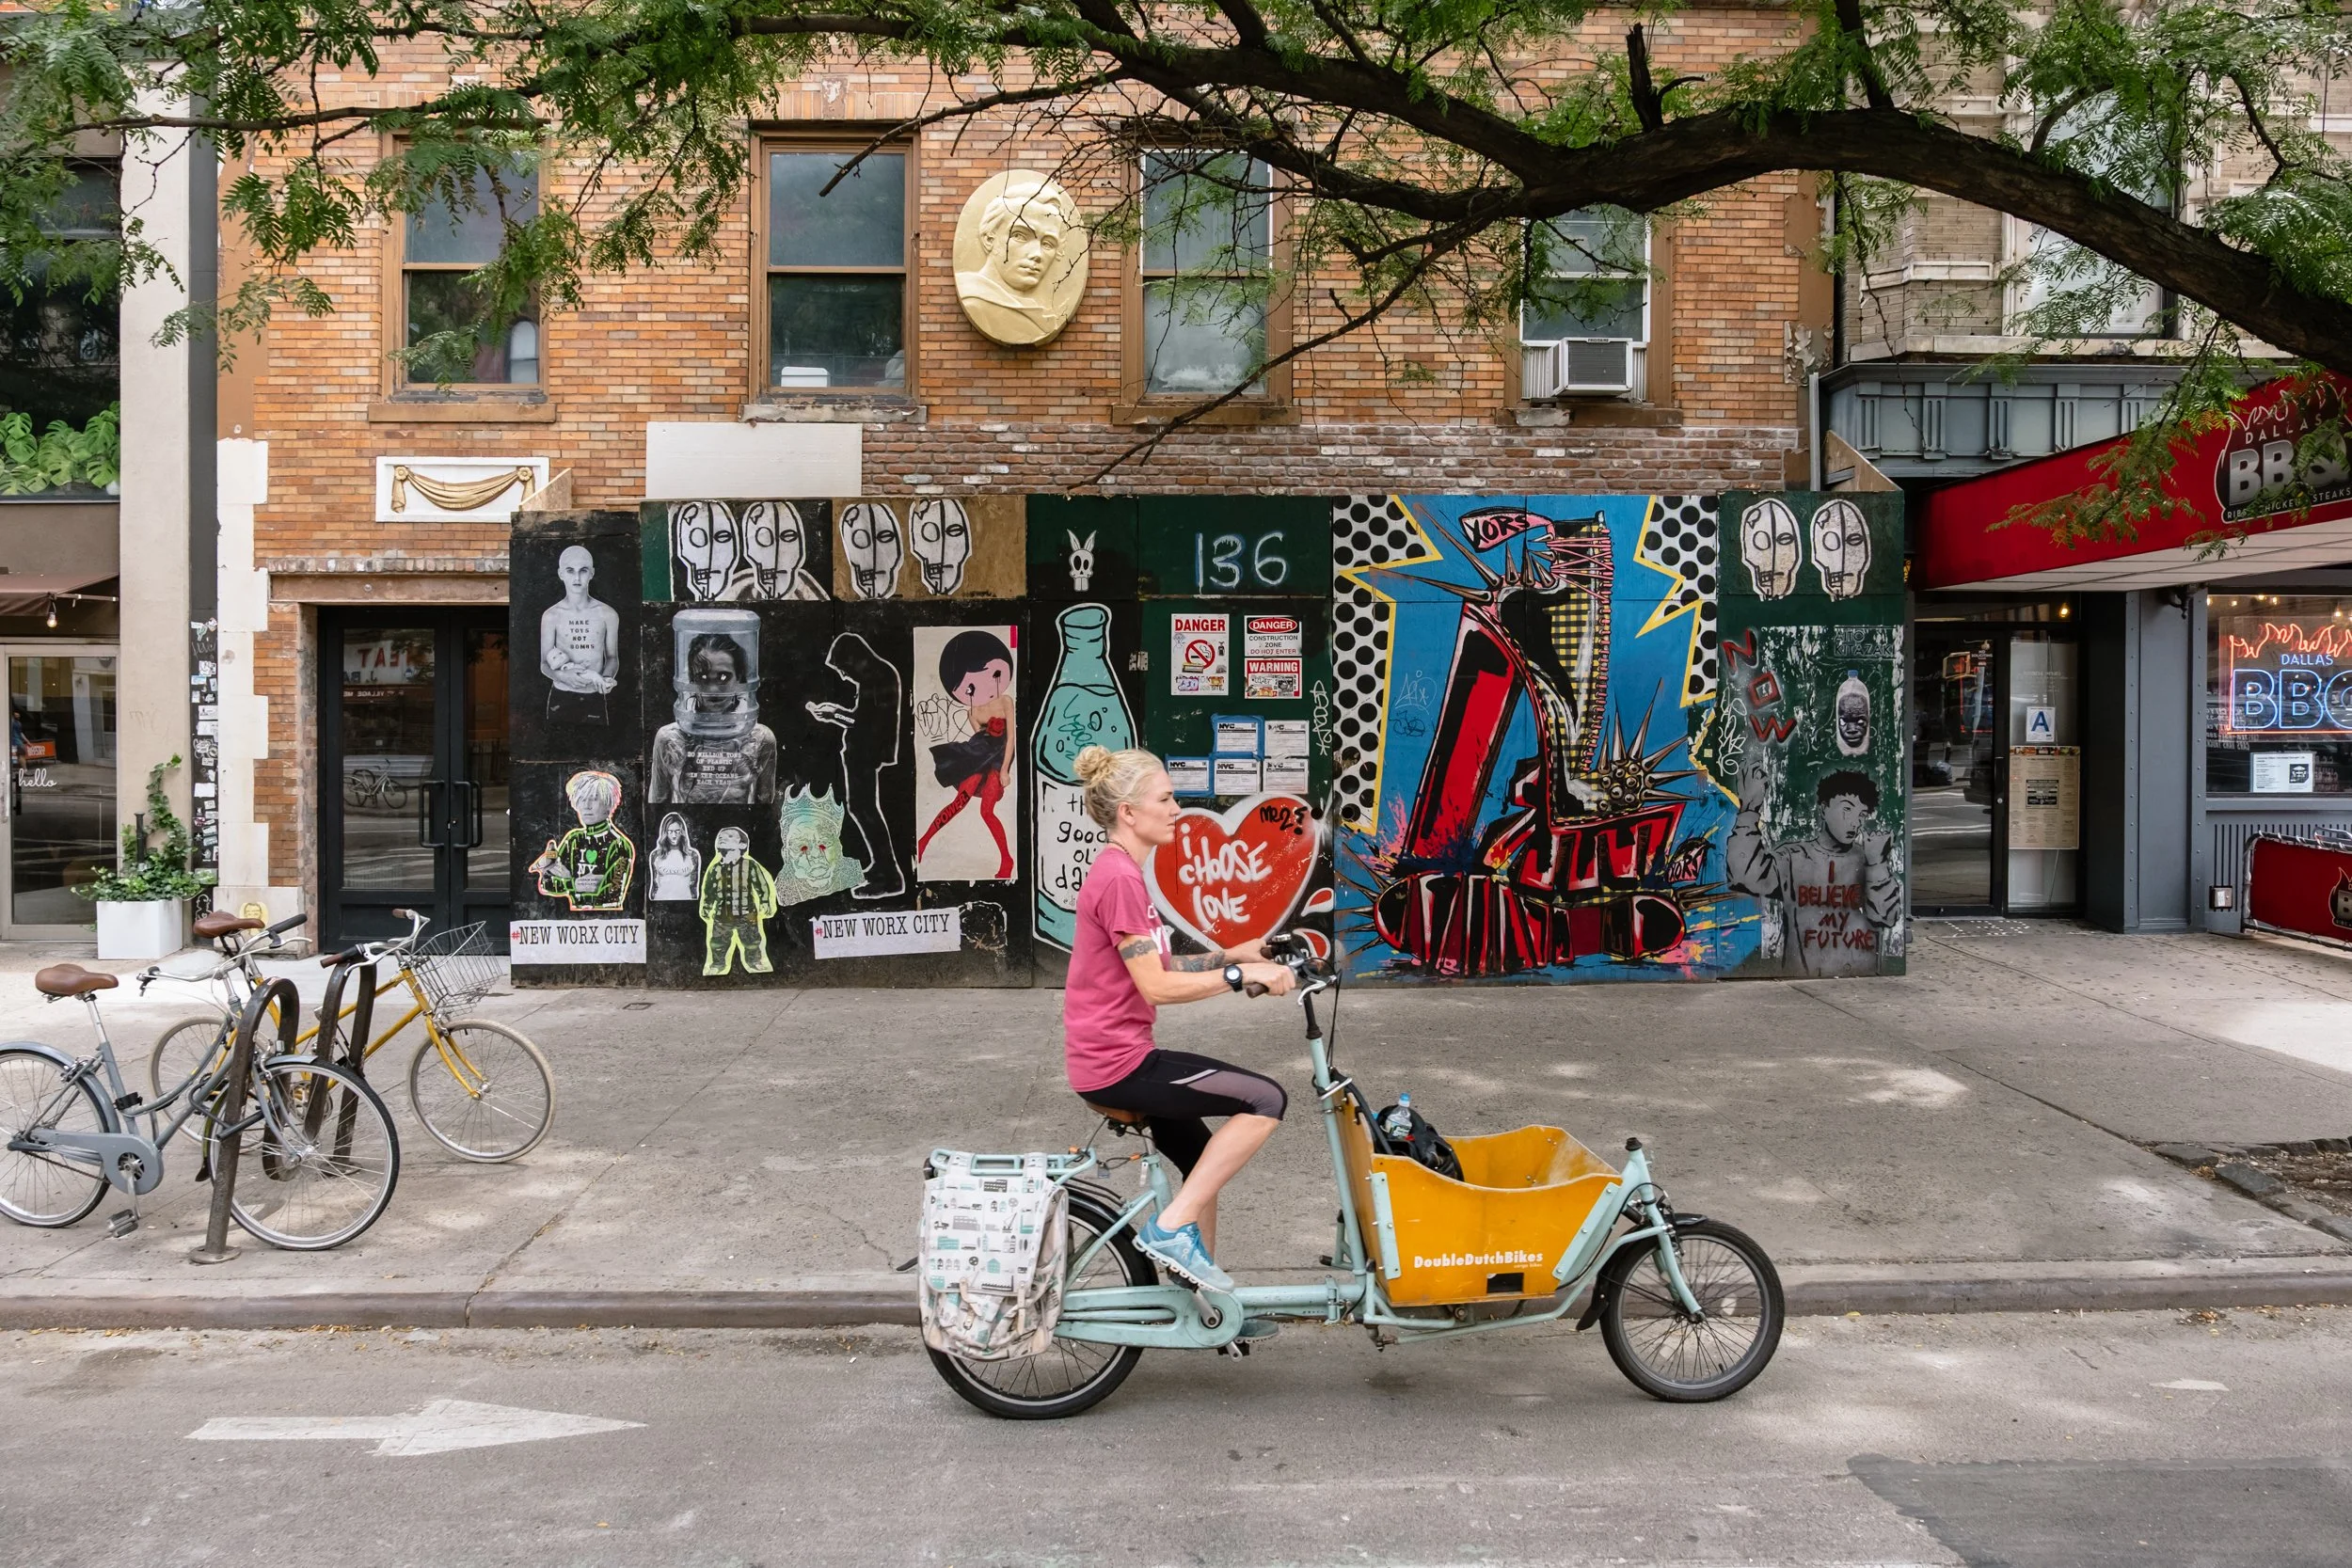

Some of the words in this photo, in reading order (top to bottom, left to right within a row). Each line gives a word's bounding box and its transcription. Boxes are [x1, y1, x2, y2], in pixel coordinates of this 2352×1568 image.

[2245, 414, 2323, 444] DALLAS
[2312, 487, 2352, 502] STEAKS
[1197, 532, 1287, 589] 136
[1174, 619, 1226, 632] DANGER
[1252, 621, 1295, 630] DANGER
[1249, 662, 1298, 673] WARNING
[2280, 654, 2334, 666] DALLAS
[2030, 711, 2050, 732] A
[18, 768, 57, 787] hello
[579, 848, 587, 863] I
[577, 863, 598, 877] NY
[862, 915, 909, 936] WORX
[913, 913, 950, 934] CITY
[1819, 911, 1851, 931] MY
[556, 926, 600, 944] WORX
[604, 925, 640, 944] CITY
[1804, 928, 1876, 950] FUTURE
[1413, 1249, 1544, 1269] DoubleDutchBikes
